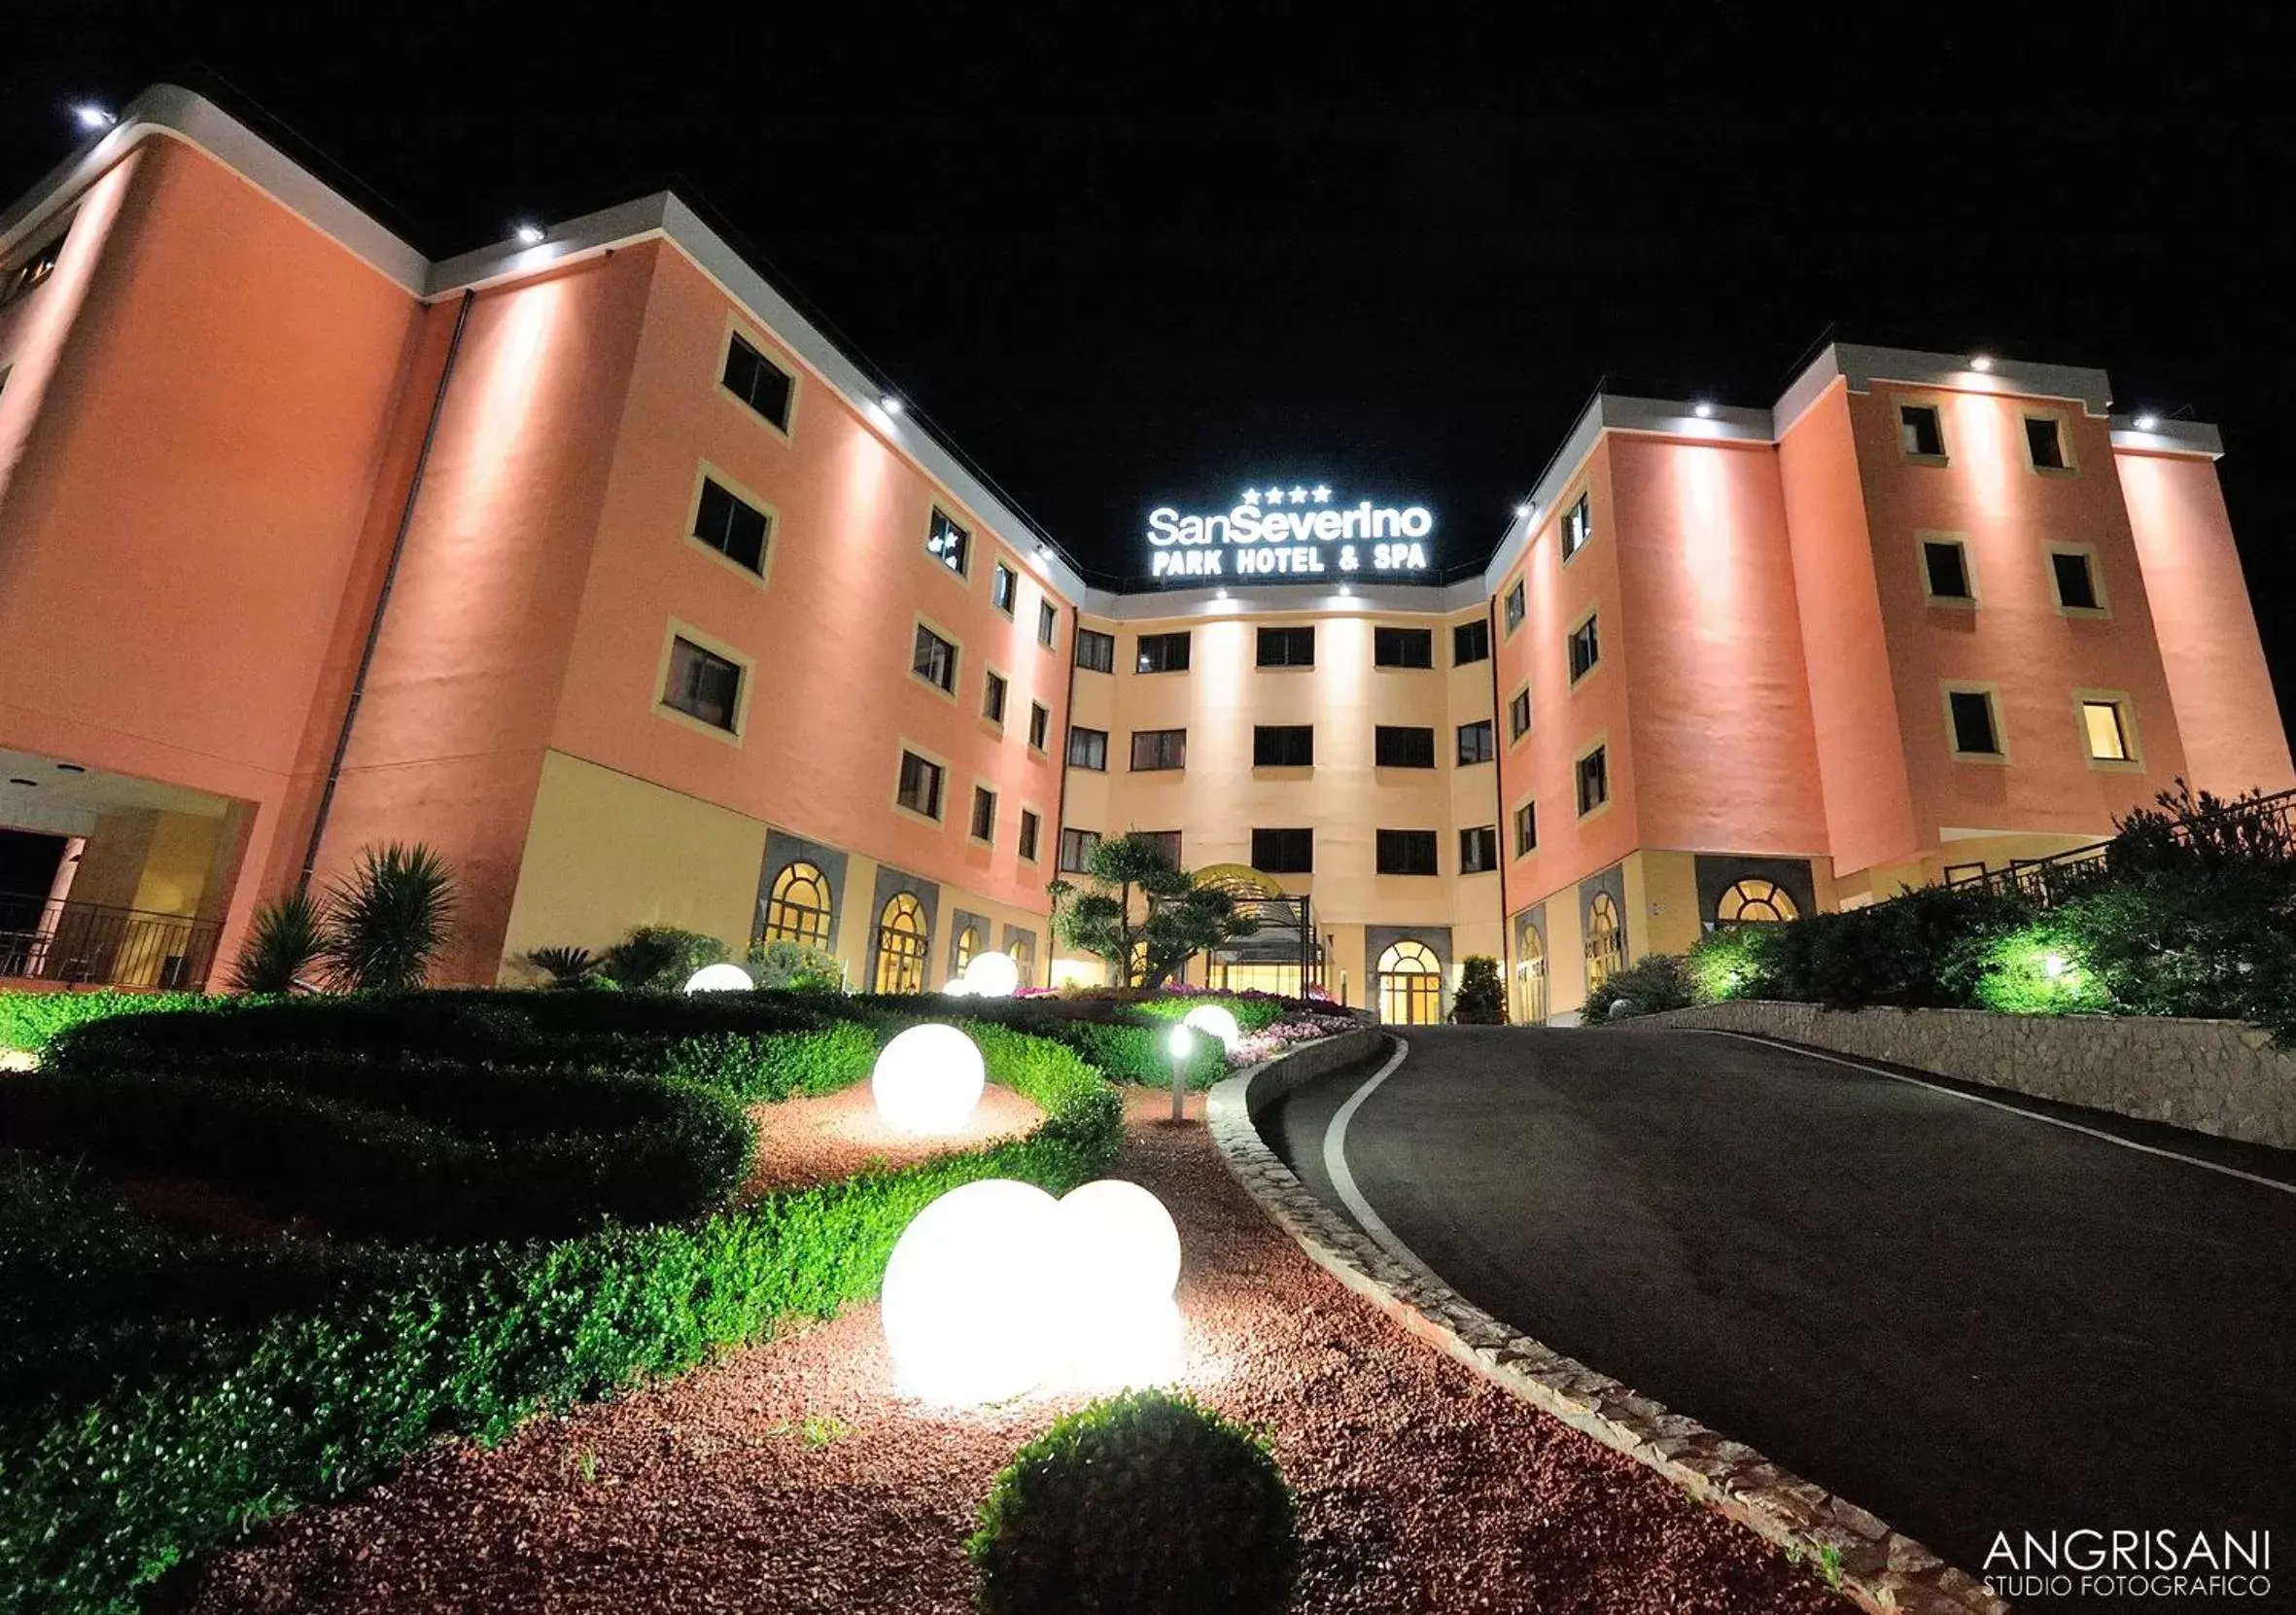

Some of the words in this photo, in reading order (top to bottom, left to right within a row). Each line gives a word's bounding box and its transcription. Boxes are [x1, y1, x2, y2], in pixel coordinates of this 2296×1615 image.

[1147, 502, 1432, 545] SanSeverino
[1152, 550, 1222, 576] PARK
[1236, 546, 1324, 574] HOTEL
[1339, 544, 1359, 571] &
[1374, 543, 1427, 569] SPA
